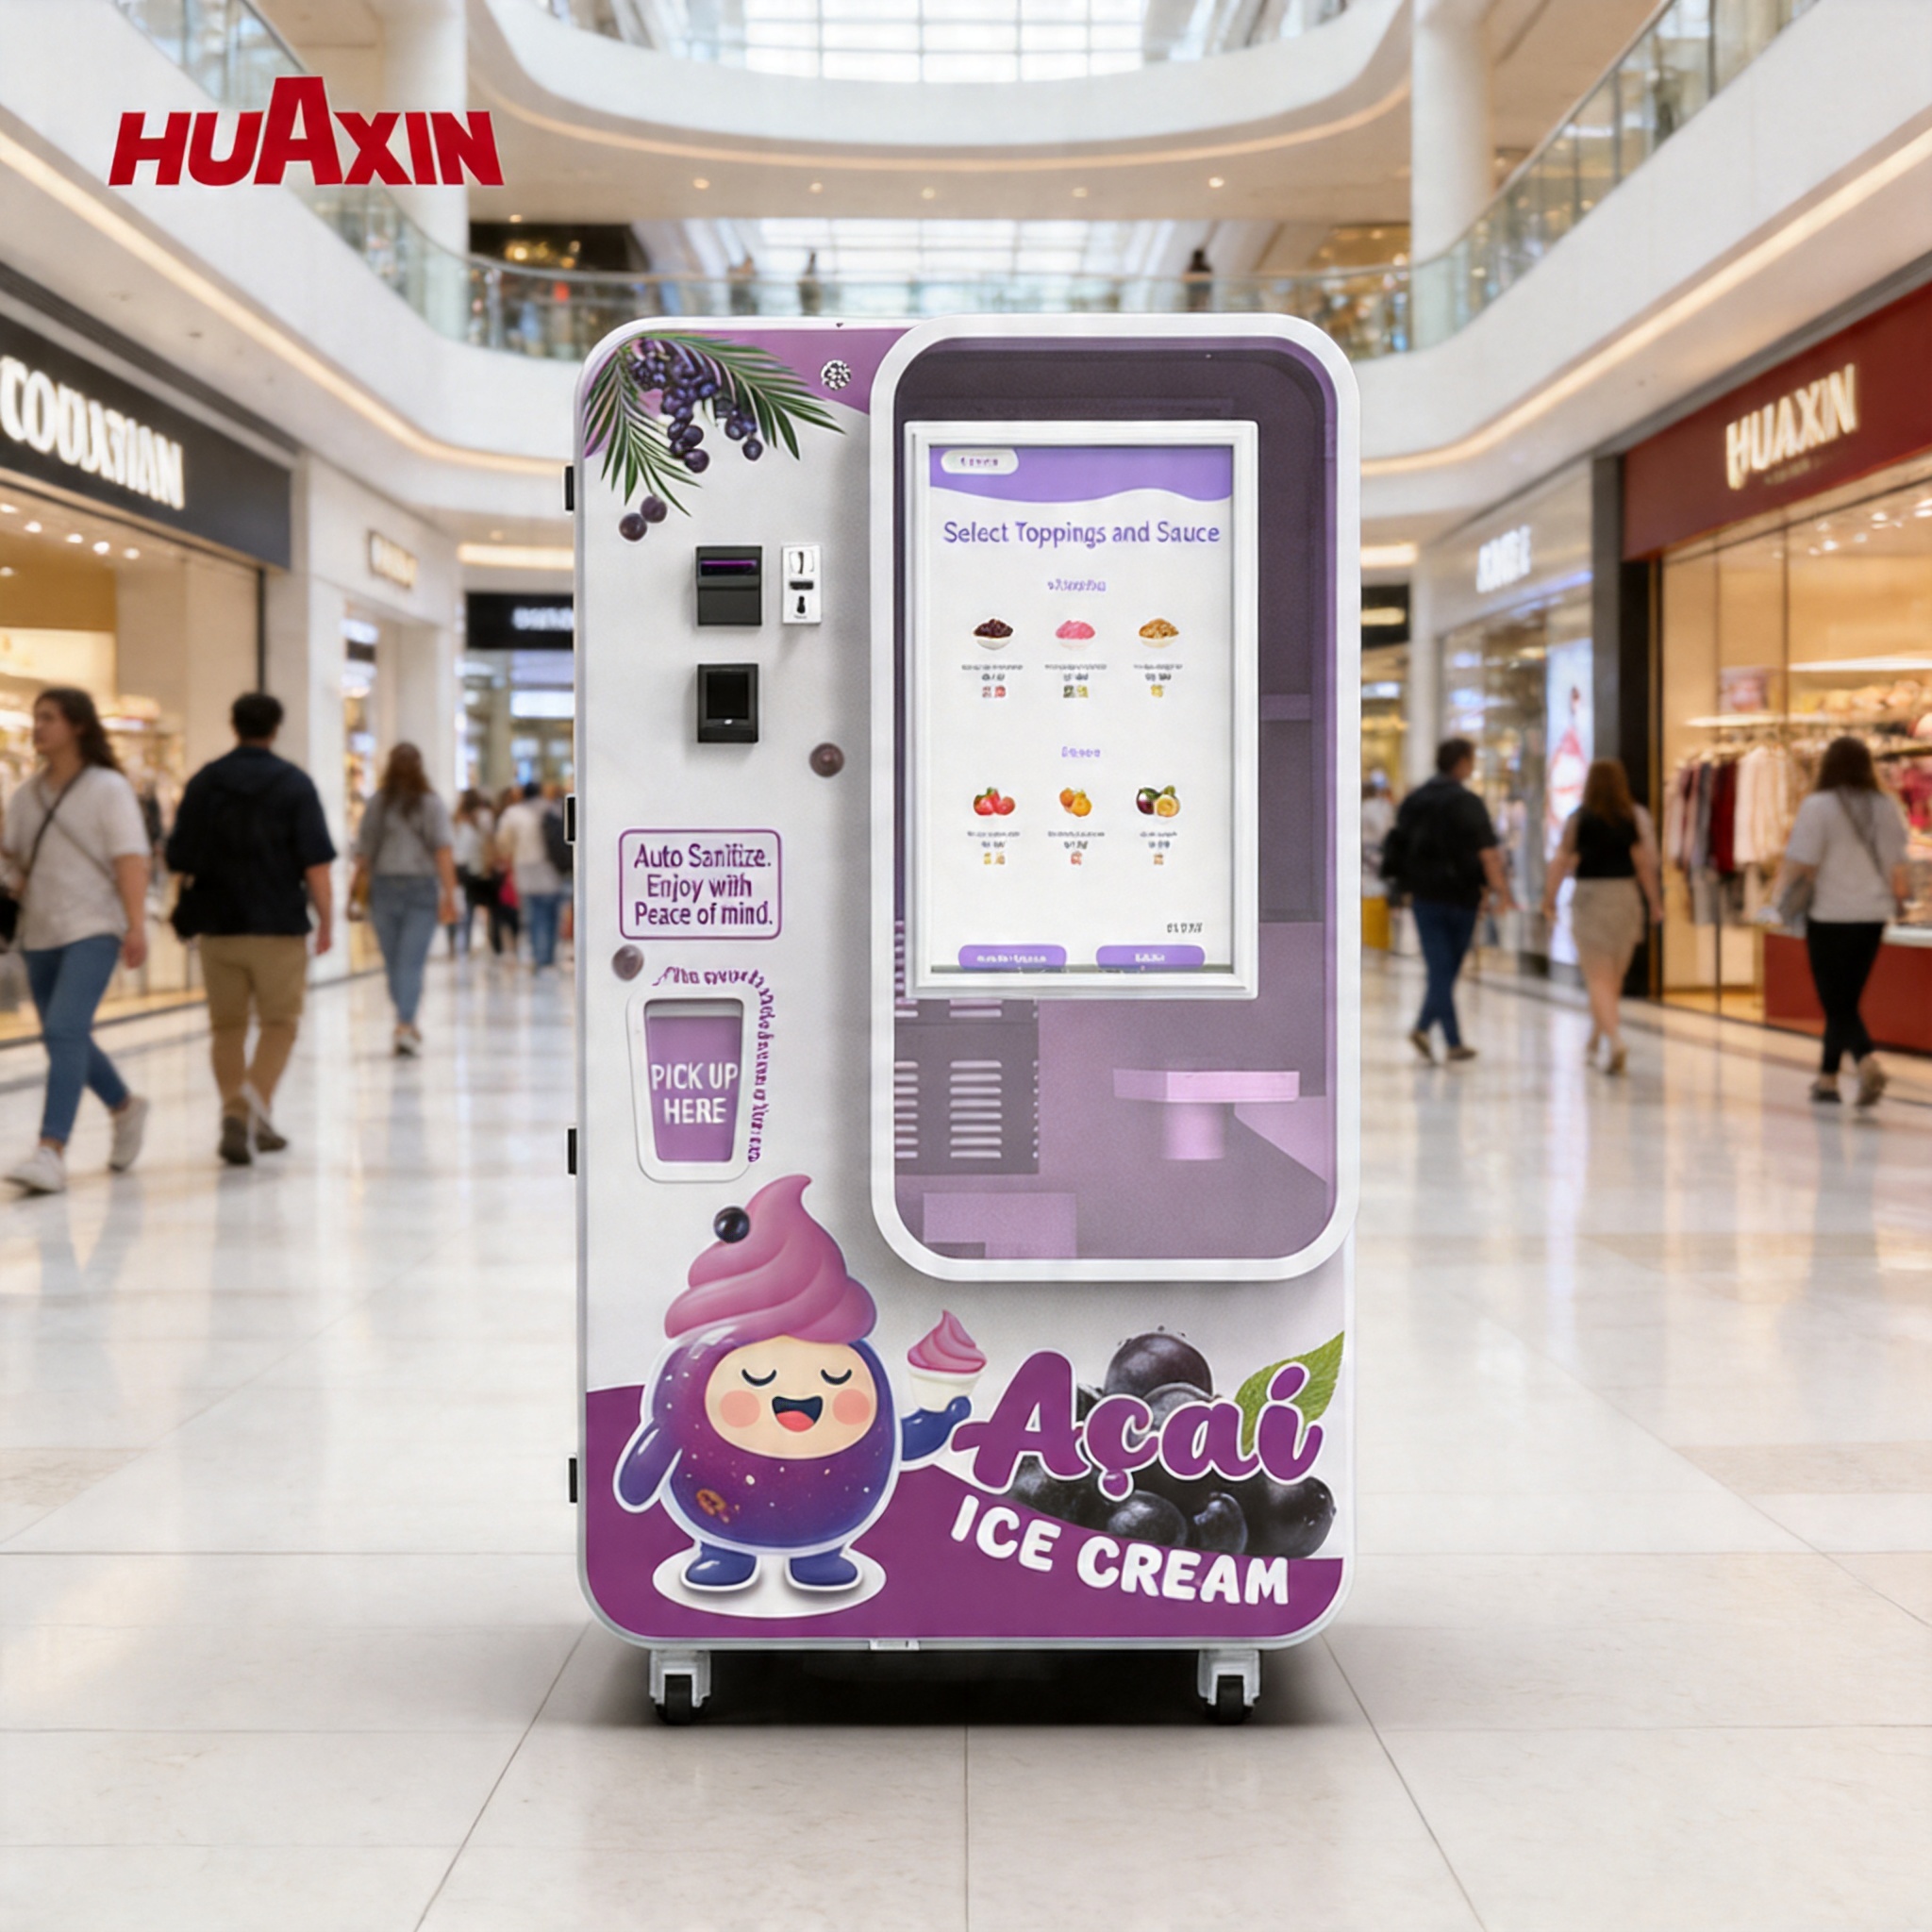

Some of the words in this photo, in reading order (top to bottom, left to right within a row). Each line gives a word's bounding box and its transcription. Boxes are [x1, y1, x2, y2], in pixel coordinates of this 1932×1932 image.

[1725, 362, 1857, 491] HUAXIN
[943, 521, 1008, 543] Select
[1016, 522, 1107, 549] Toppings
[1112, 521, 1150, 543] and
[1157, 521, 1221, 543] Sauce
[634, 842, 683, 869] Auto
[688, 842, 772, 869] Sanitize.
[647, 874, 704, 903] Enjoy
[709, 874, 752, 898] with
[635, 902, 691, 926] Peace
[697, 903, 717, 925] of
[721, 901, 773, 925] mind.
[651, 1063, 705, 1091] PICK
[709, 1062, 739, 1090] UP
[663, 1097, 727, 1124] HERE
[950, 1349, 1324, 1501] Açai
[951, 1494, 1061, 1572] ICE
[1076, 1536, 1289, 1606] CREAM
